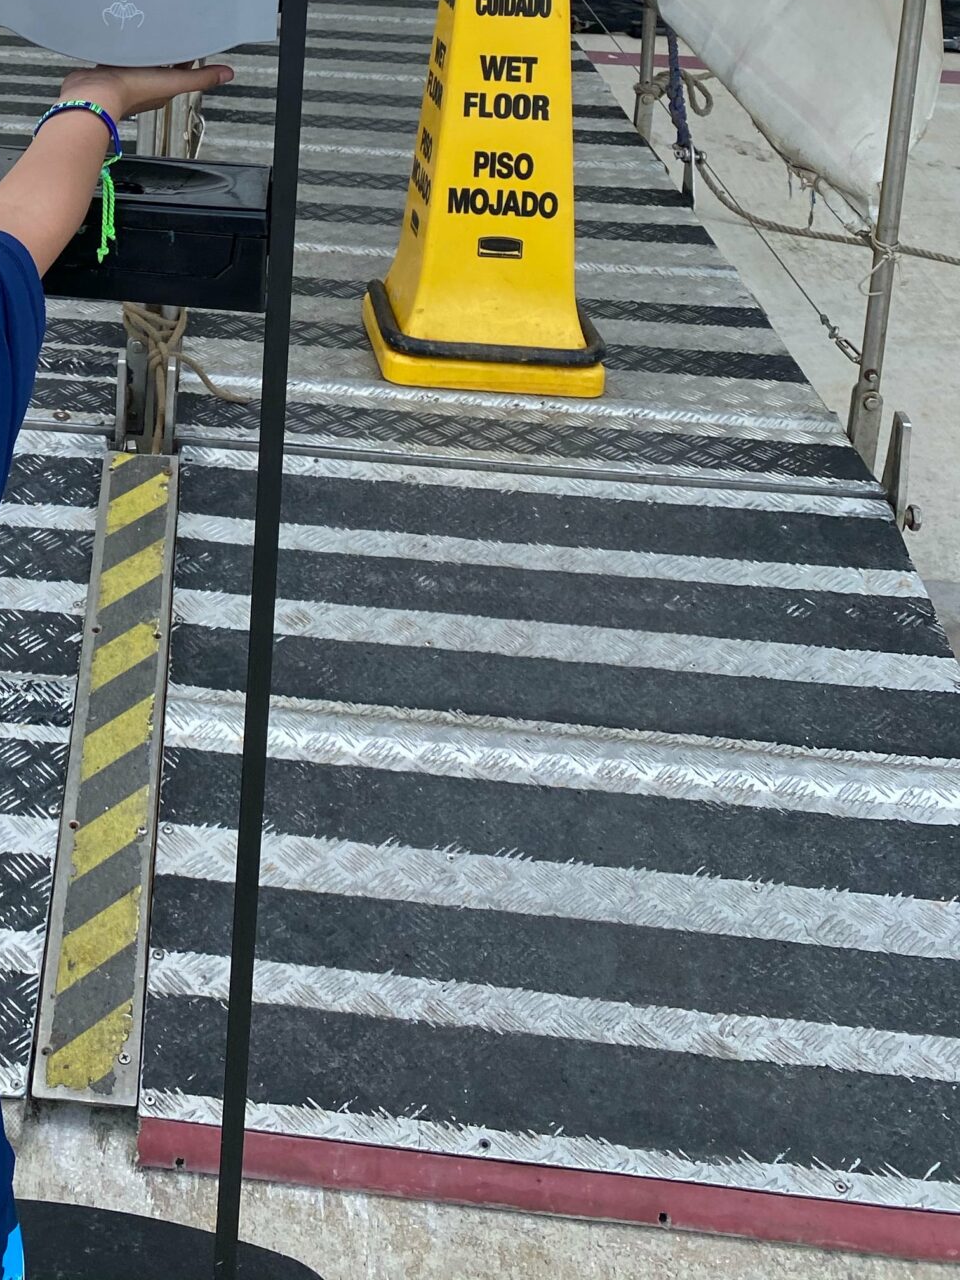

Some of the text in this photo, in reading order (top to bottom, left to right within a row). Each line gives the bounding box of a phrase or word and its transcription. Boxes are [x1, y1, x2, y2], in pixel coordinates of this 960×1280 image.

[480, 55, 538, 83] WET
[463, 92, 550, 121] FLOOR
[473, 150, 534, 181] PISO
[447, 187, 559, 219] MOJADO
